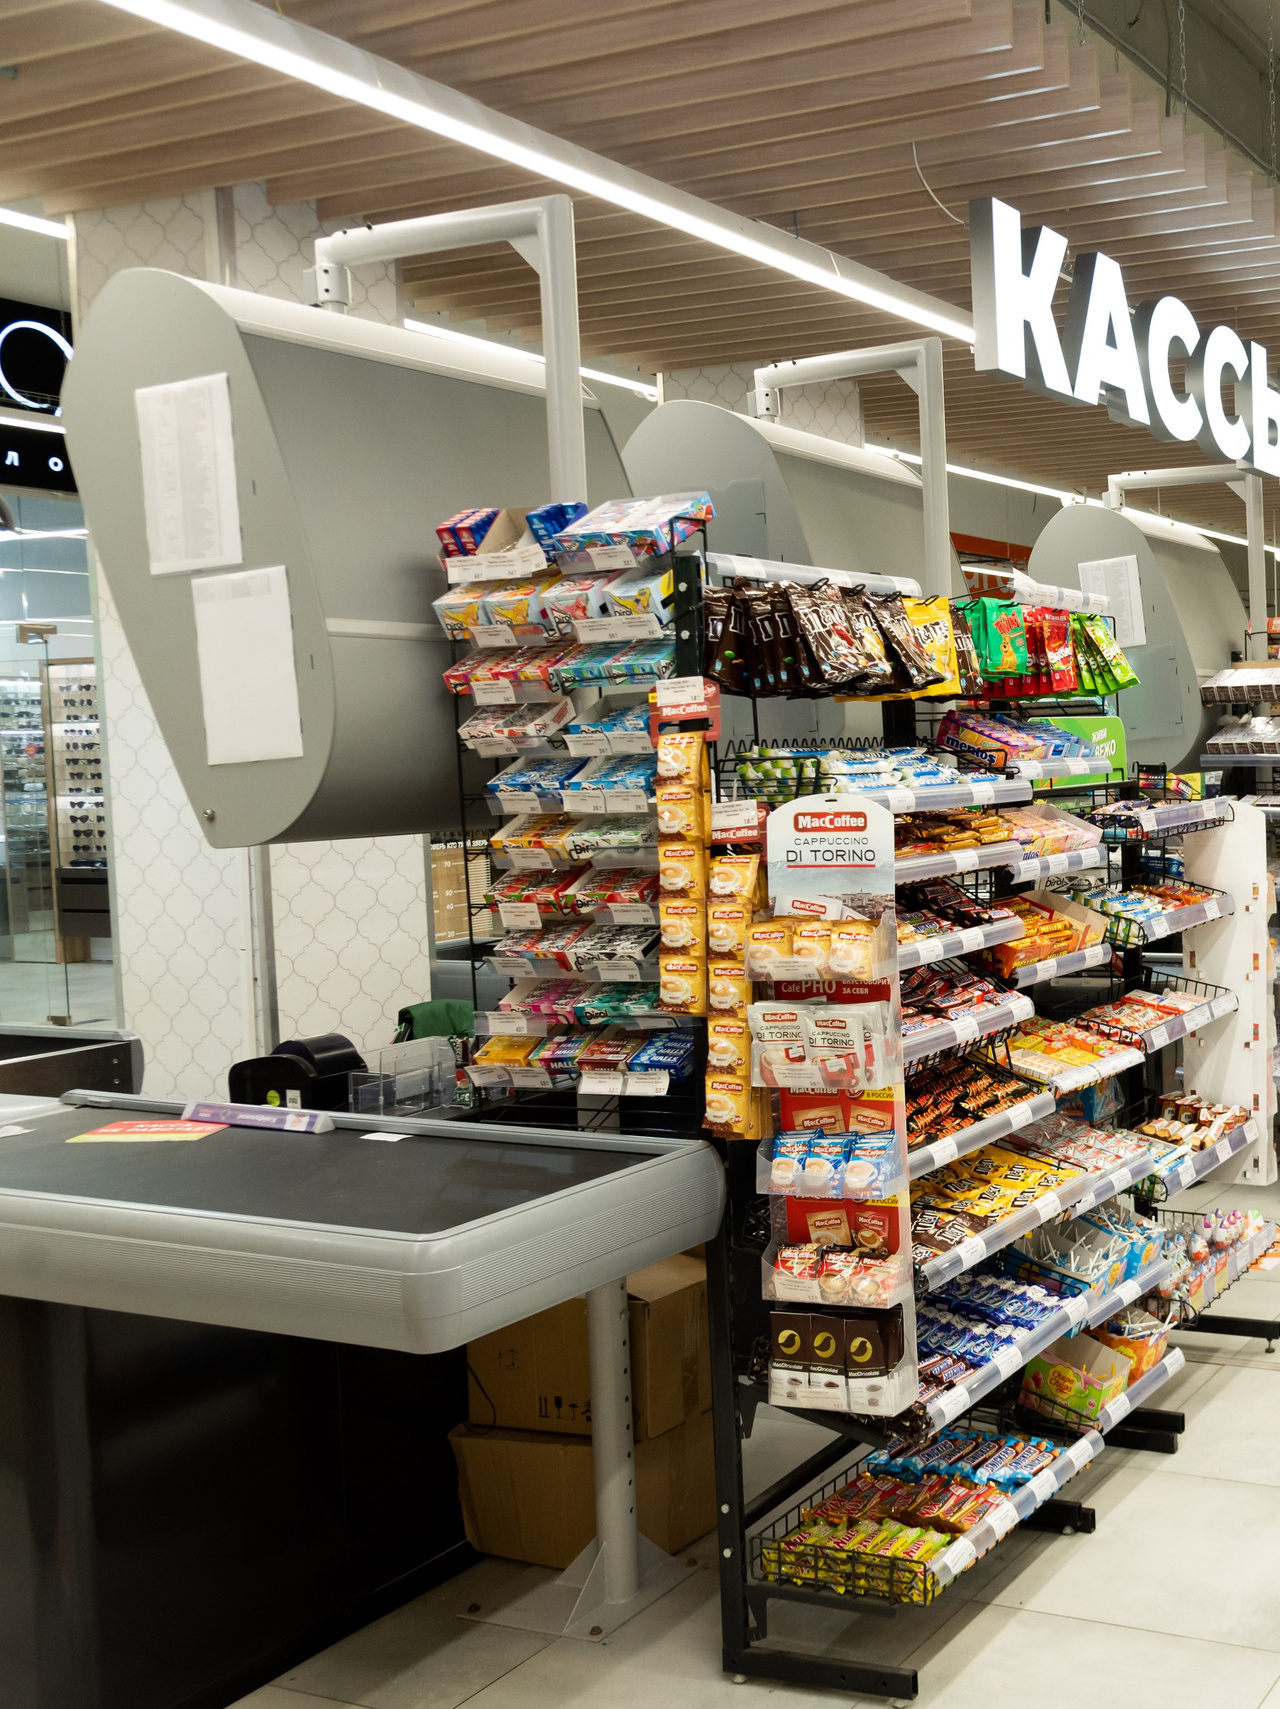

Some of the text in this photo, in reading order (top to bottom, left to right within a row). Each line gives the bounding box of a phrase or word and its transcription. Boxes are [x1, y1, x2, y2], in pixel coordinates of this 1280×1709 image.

[662, 704, 708, 716] MacCoffee
[1092, 727, 1107, 742] ЖИВИ
[945, 734, 997, 765] mentos
[798, 814, 865, 829] MacCoffee
[712, 828, 758, 840] MacCoffee
[794, 837, 869, 846] CAPPUCCINO
[786, 850, 876, 863] DI TORINO
[793, 901, 827, 914] MacCoffee
[1040, 922, 1062, 933] MELLER
[1012, 957, 1039, 968] MELLER
[585, 1009, 609, 1020] Dirol
[816, 1020, 846, 1028] MacCoffee
[809, 1037, 855, 1046] DI TORINO
[550, 1061, 578, 1070] HALLS
[712, 1082, 743, 1091] MacCoffee
[803, 1117, 835, 1127] MacCoffee
[857, 1114, 885, 1127] MacCoffee
[815, 1219, 841, 1227] MacCoffee
[859, 1216, 884, 1226] MacCoffee
[848, 1370, 880, 1378] MacChocolate
[1052, 1370, 1074, 1385] Chupa
[1050, 1379, 1073, 1394] Chups
[921, 1441, 953, 1464] SNICKERS
[1007, 1445, 1040, 1469] SNICKERS
[984, 1446, 1016, 1473] SNICKERS
[1022, 1452, 1053, 1472] SNICKERS
